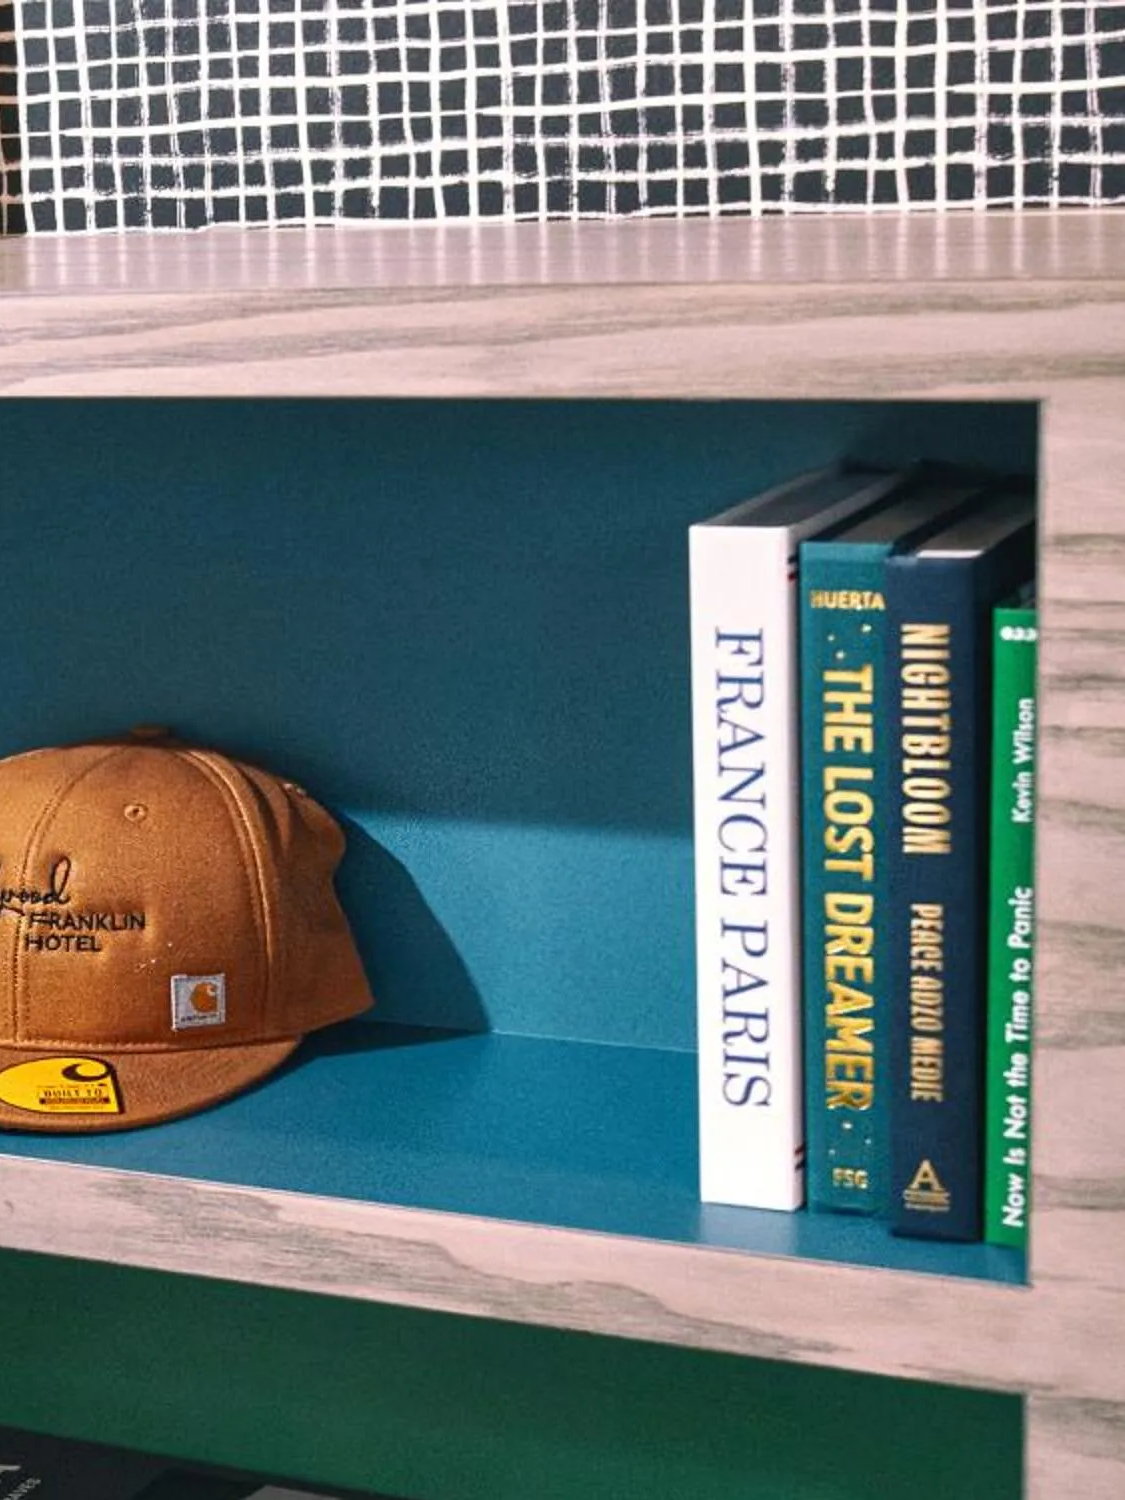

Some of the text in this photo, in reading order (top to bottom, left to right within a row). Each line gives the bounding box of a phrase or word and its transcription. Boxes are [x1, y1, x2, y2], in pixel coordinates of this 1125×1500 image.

[810, 590, 886, 611] HUERTA
[900, 623, 952, 854] NIGHTBLOOM
[1011, 698, 1035, 823] Kevin Wilson
[25, 934, 102, 952] HOTEL
[29, 911, 146, 931] FRANKLIN
[715, 627, 771, 1107] FRANCE PARIS
[823, 664, 874, 1111] THE LOST DREAMER
[910, 903, 944, 1103] PEACE ADZO MEDIE
[1001, 886, 1033, 1228] Now Is Not the Time to Panic
